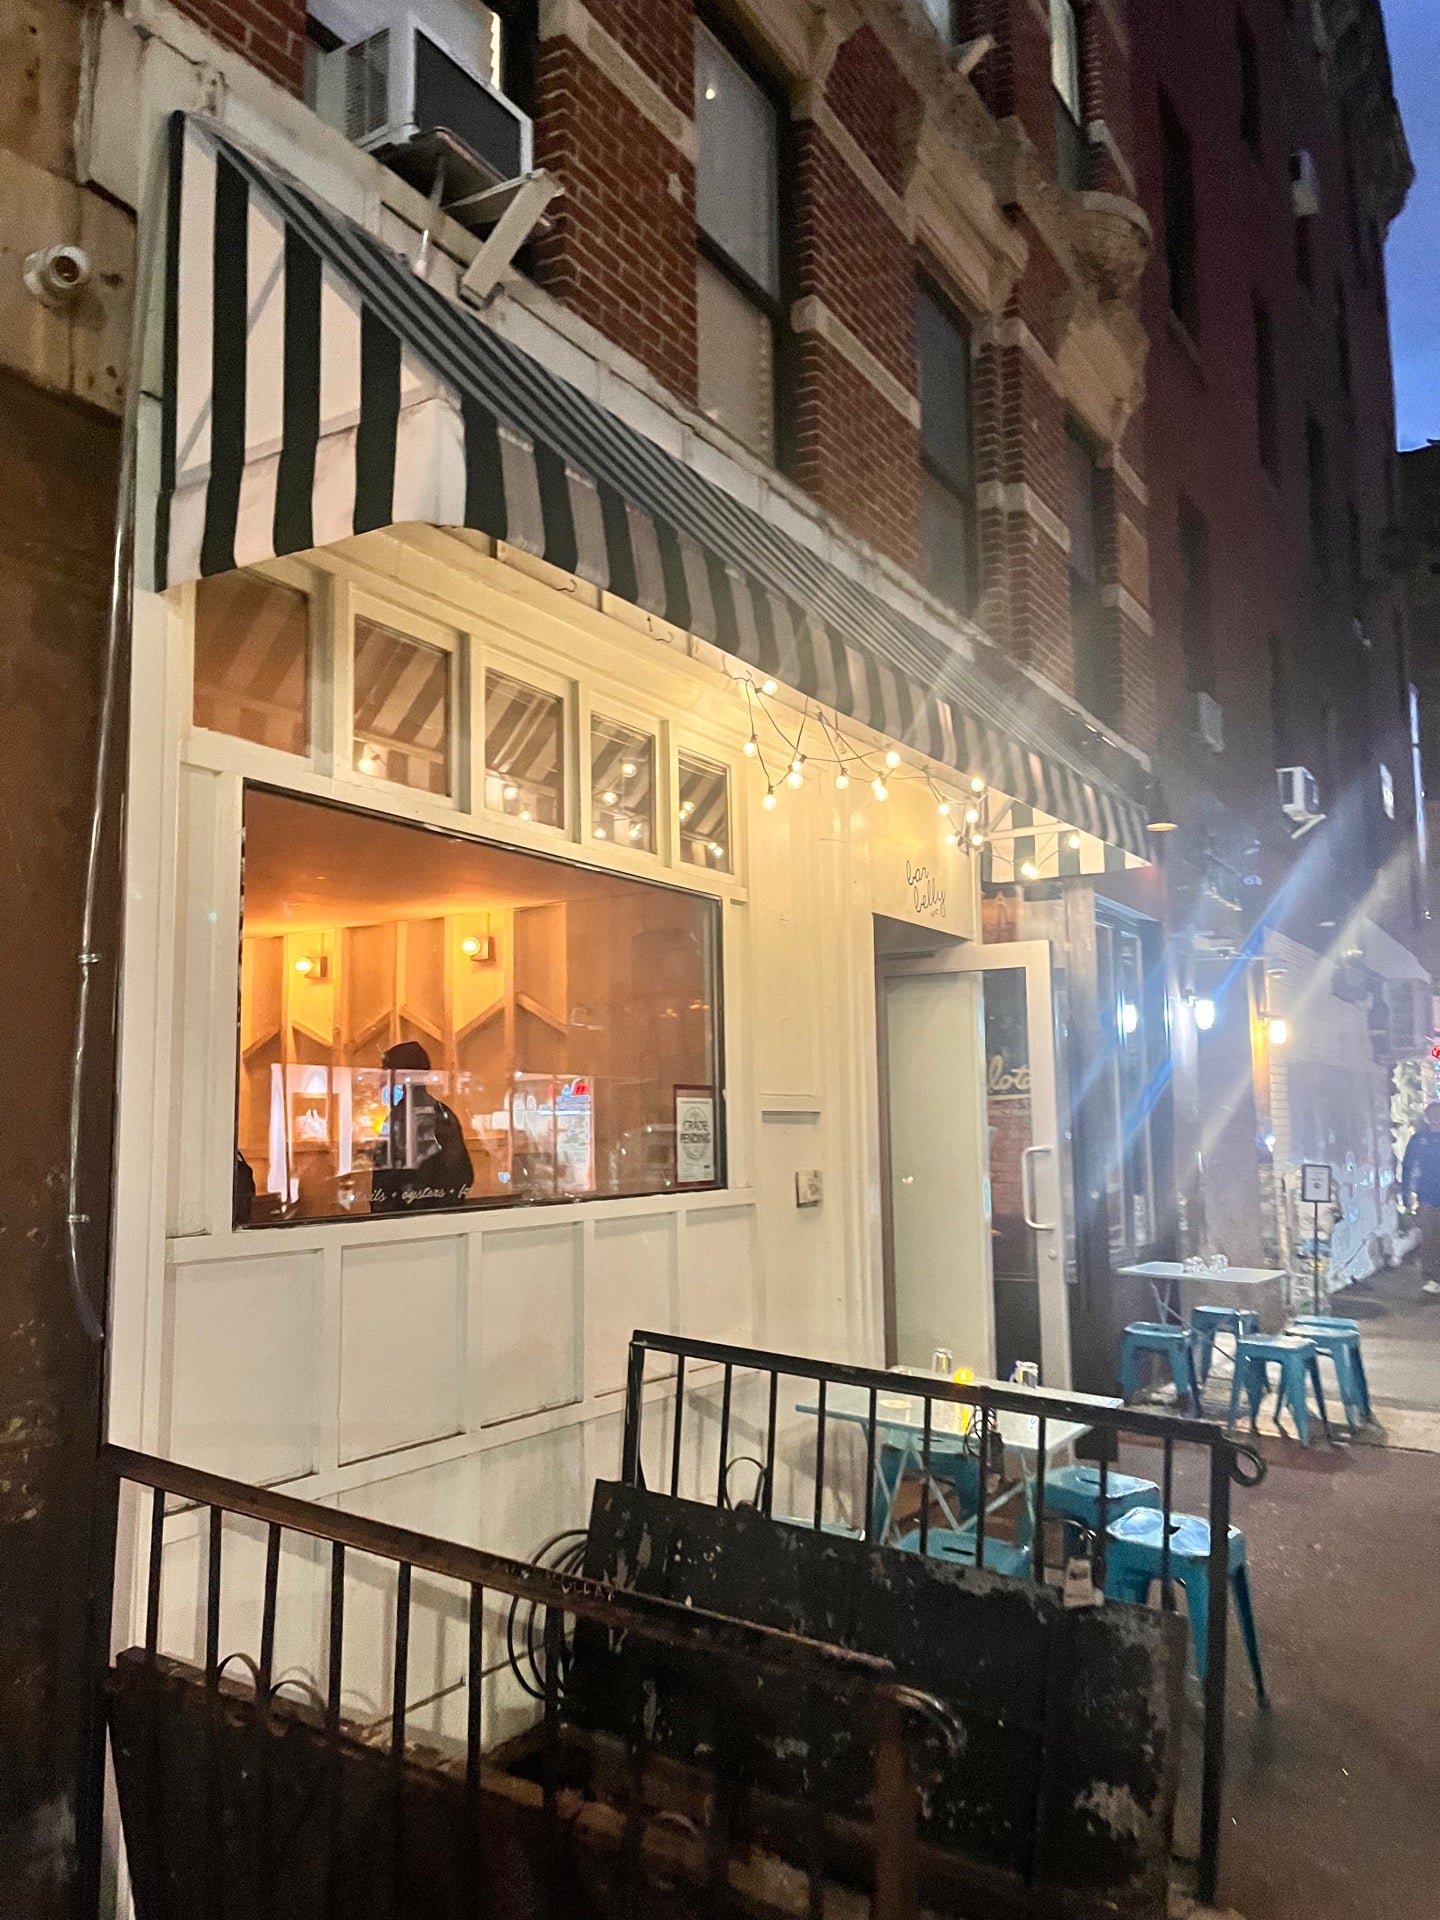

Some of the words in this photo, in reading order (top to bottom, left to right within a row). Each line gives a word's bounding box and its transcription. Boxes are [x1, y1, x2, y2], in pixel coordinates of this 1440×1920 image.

[905, 859, 929, 886] bar
[913, 877, 946, 918] belly
[682, 1120, 709, 1131] GRADE
[401, 1186, 446, 1204] oysters
